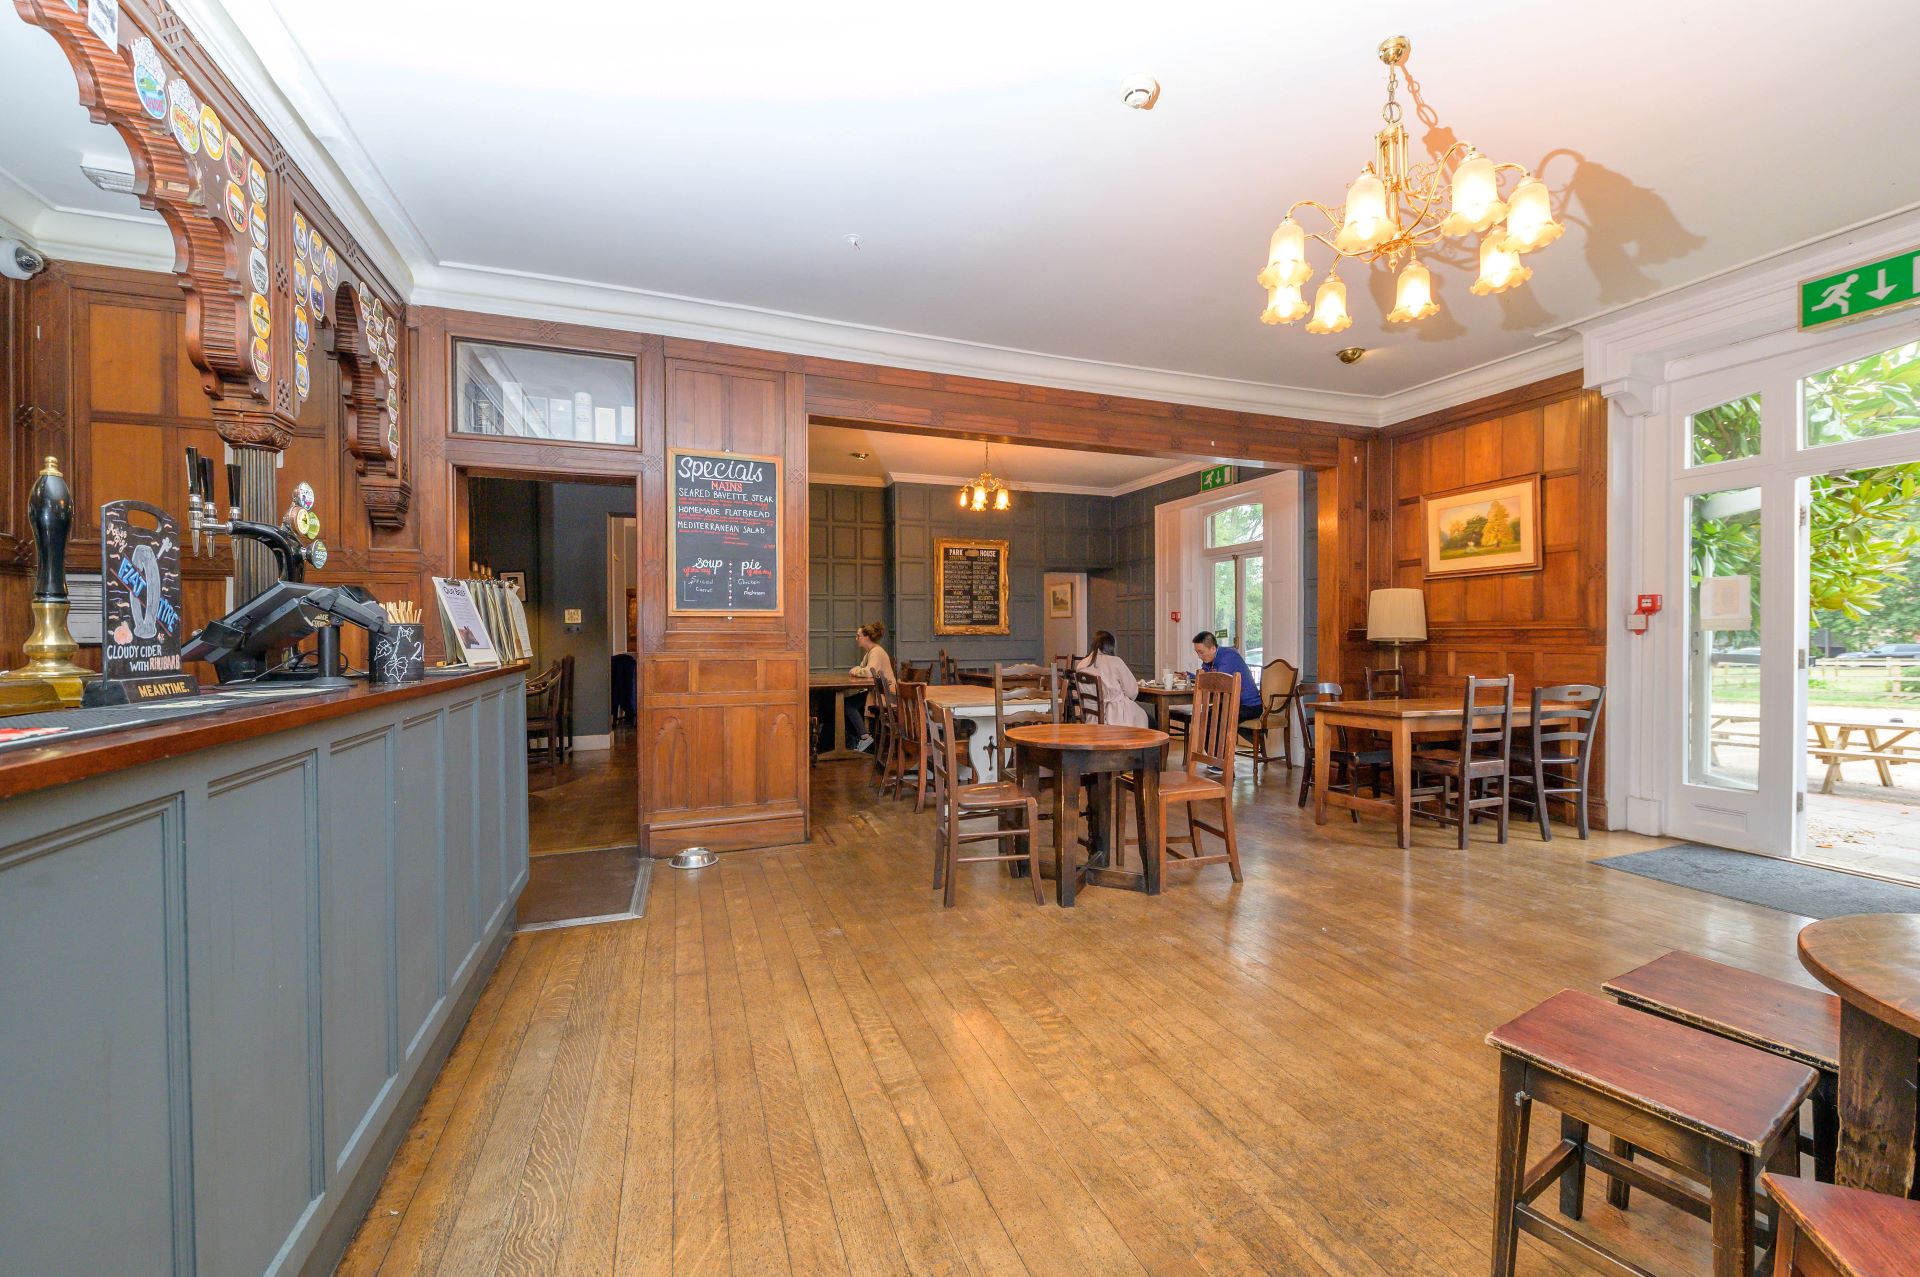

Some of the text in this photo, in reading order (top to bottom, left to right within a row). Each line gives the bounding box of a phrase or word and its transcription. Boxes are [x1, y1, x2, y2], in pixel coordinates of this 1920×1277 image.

[678, 456, 763, 482] Specials
[712, 480, 743, 492] MAINS
[678, 488, 774, 503] SEARED BAVETTE STEAK
[678, 506, 770, 518] HOMEMADE FLATBREAD
[677, 521, 740, 532] MEDITERRANEAN
[692, 557, 723, 574] soup
[741, 559, 762, 576] pie
[118, 557, 147, 597] FLAT
[157, 596, 179, 632] TYRE
[107, 644, 162, 660] CLOUDY CIDER
[130, 654, 180, 672] WITH RHUBARB
[138, 681, 190, 698] MEANTIME.
